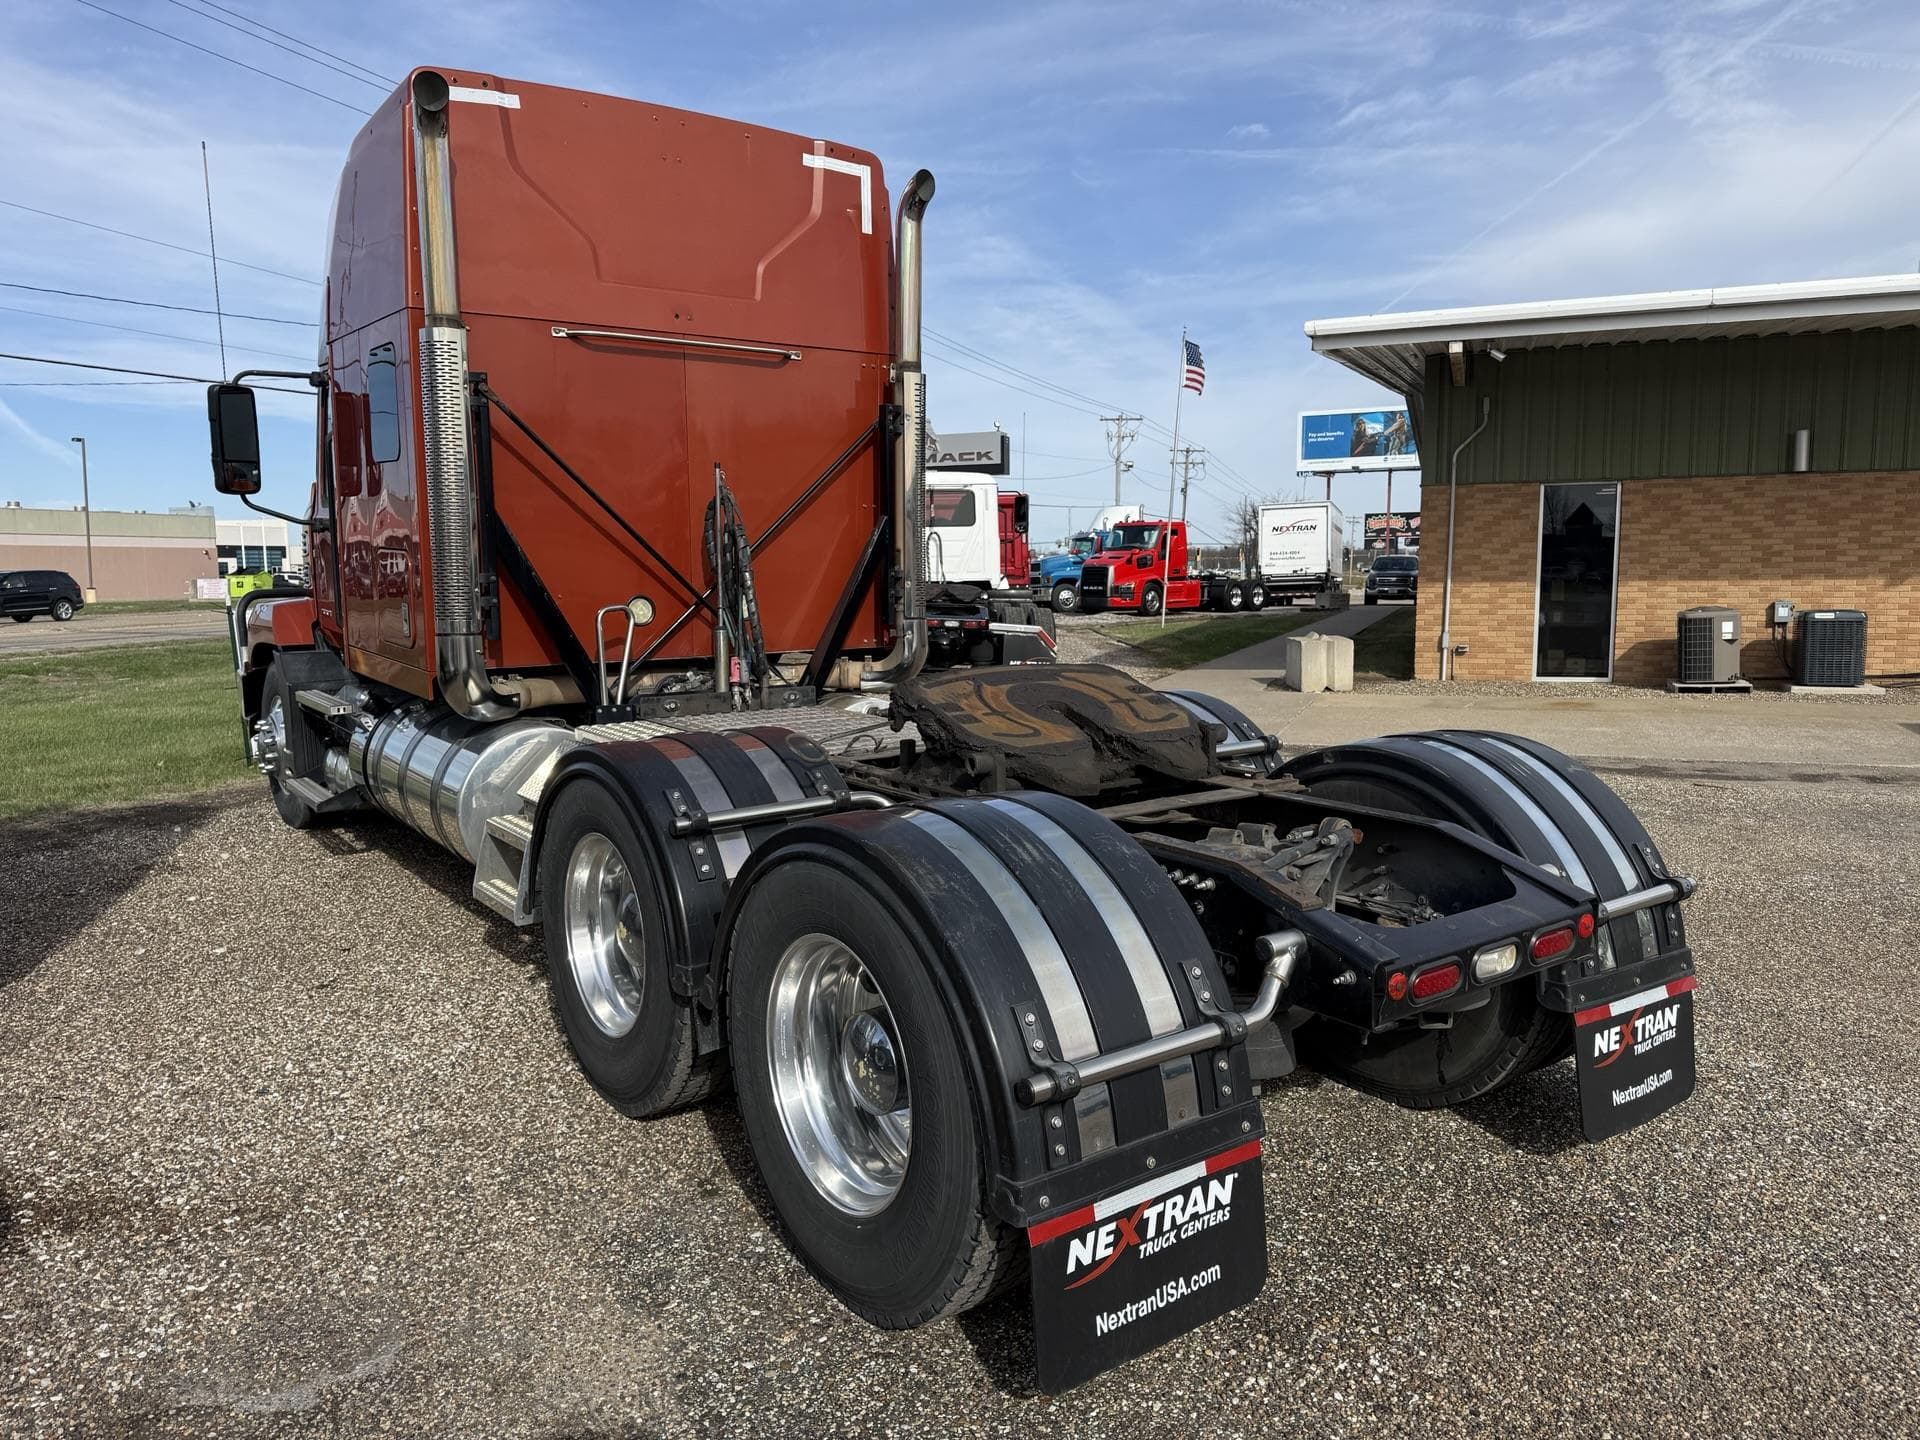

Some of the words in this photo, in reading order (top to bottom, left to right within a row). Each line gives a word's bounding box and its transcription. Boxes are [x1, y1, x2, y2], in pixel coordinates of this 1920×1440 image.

[1271, 523, 1318, 534] NEXTRAN
[1594, 1004, 1680, 1058] NEXTRAN
[1634, 1037, 1653, 1056] TRUCK
[1653, 1028, 1676, 1049] CENTERS
[1612, 1068, 1673, 1107] NextranUSA.com
[1066, 1172, 1239, 1278] NEXTRAN
[1139, 1231, 1177, 1259] TRUCK
[1181, 1206, 1231, 1239] CENTERS
[1096, 1264, 1222, 1337] NextranUSA.com
